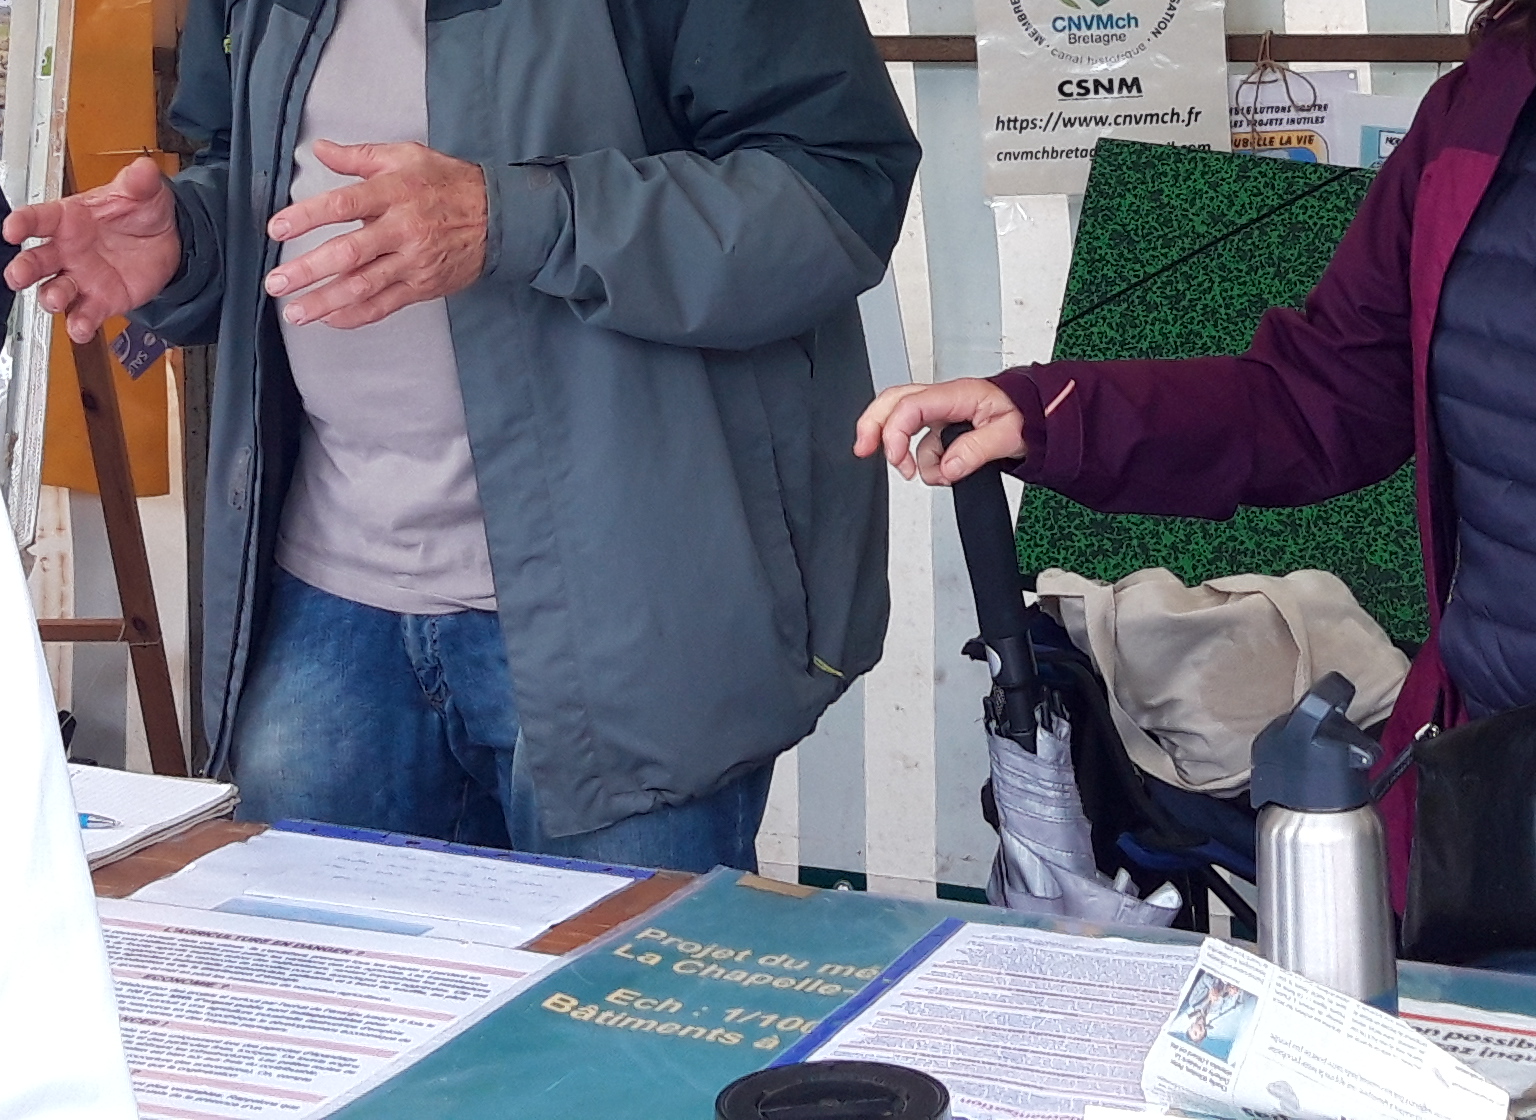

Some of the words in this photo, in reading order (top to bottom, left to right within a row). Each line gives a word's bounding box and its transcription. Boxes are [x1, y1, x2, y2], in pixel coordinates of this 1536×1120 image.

[1051, 11, 1140, 34] CNVMch
[1067, 32, 1128, 46] Bretagne
[1056, 76, 1143, 98] CSNM
[995, 108, 1203, 135] https://www.cnvmch.fr
[1279, 136, 1293, 146] LA
[1296, 134, 1315, 145] VIE
[613, 943, 662, 965] La
[635, 926, 753, 962] Projet
[758, 953, 809, 970] du
[605, 988, 684, 1014] Ech
[541, 992, 745, 1046] Bâtiments
